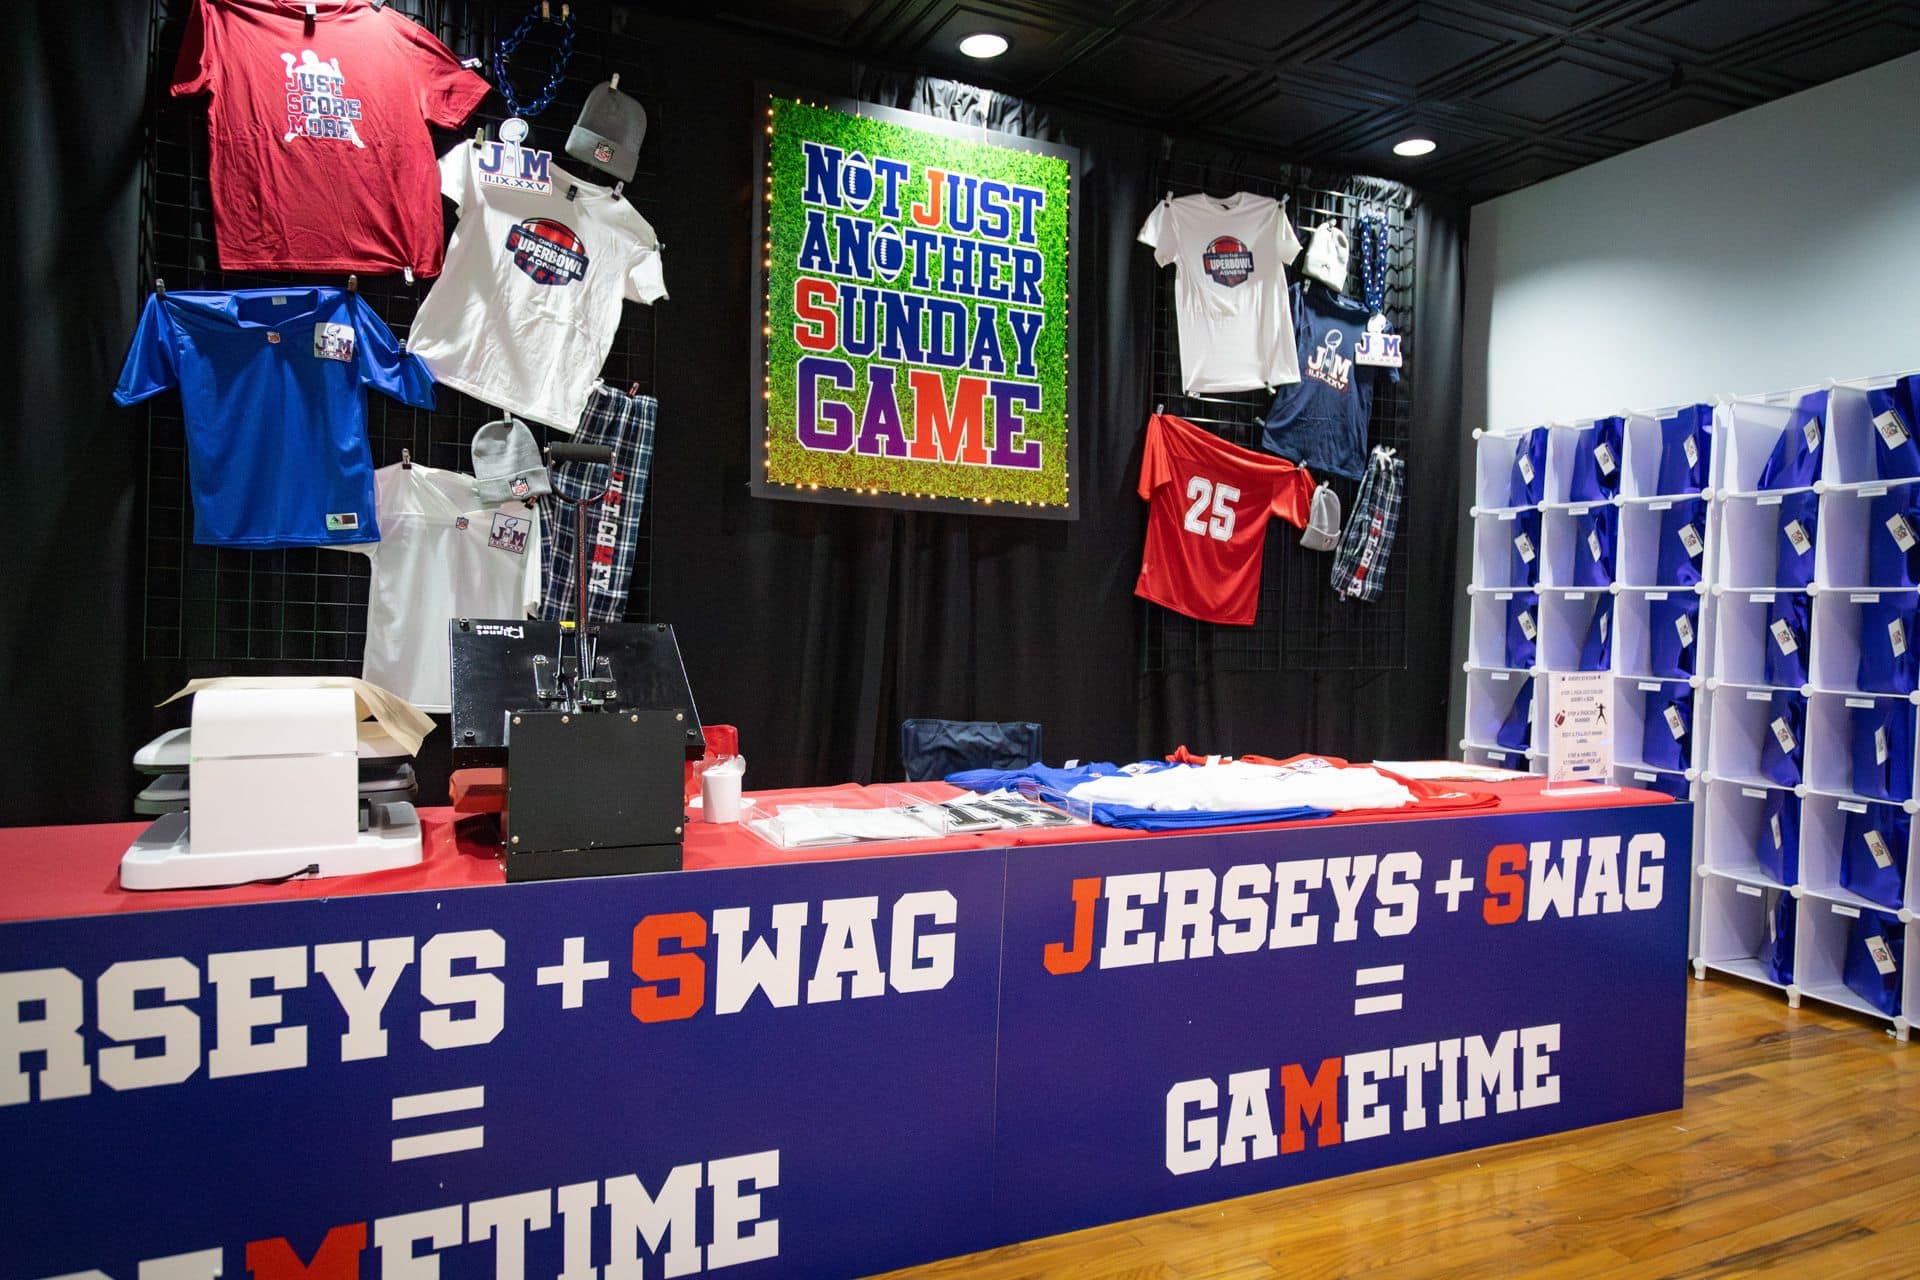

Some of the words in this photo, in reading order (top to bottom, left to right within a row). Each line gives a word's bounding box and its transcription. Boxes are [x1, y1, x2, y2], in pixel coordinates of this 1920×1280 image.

[285, 72, 344, 96] JUST
[287, 93, 361, 120] SCORE
[288, 115, 353, 140] MORE
[802, 140, 910, 220] NOT
[911, 168, 1045, 245] JUST
[797, 208, 1045, 307] ANOTHER
[794, 276, 1045, 379] SUNDAY
[796, 355, 1043, 471] GAME
[589, 521, 618, 591] COMFY
[1184, 475, 1241, 542] 25
[1043, 851, 1422, 975] JERSEYS
[1483, 832, 1666, 925] SWAG
[630, 889, 957, 1025] SWAG
[1165, 1023, 1561, 1175] GAMETIME
